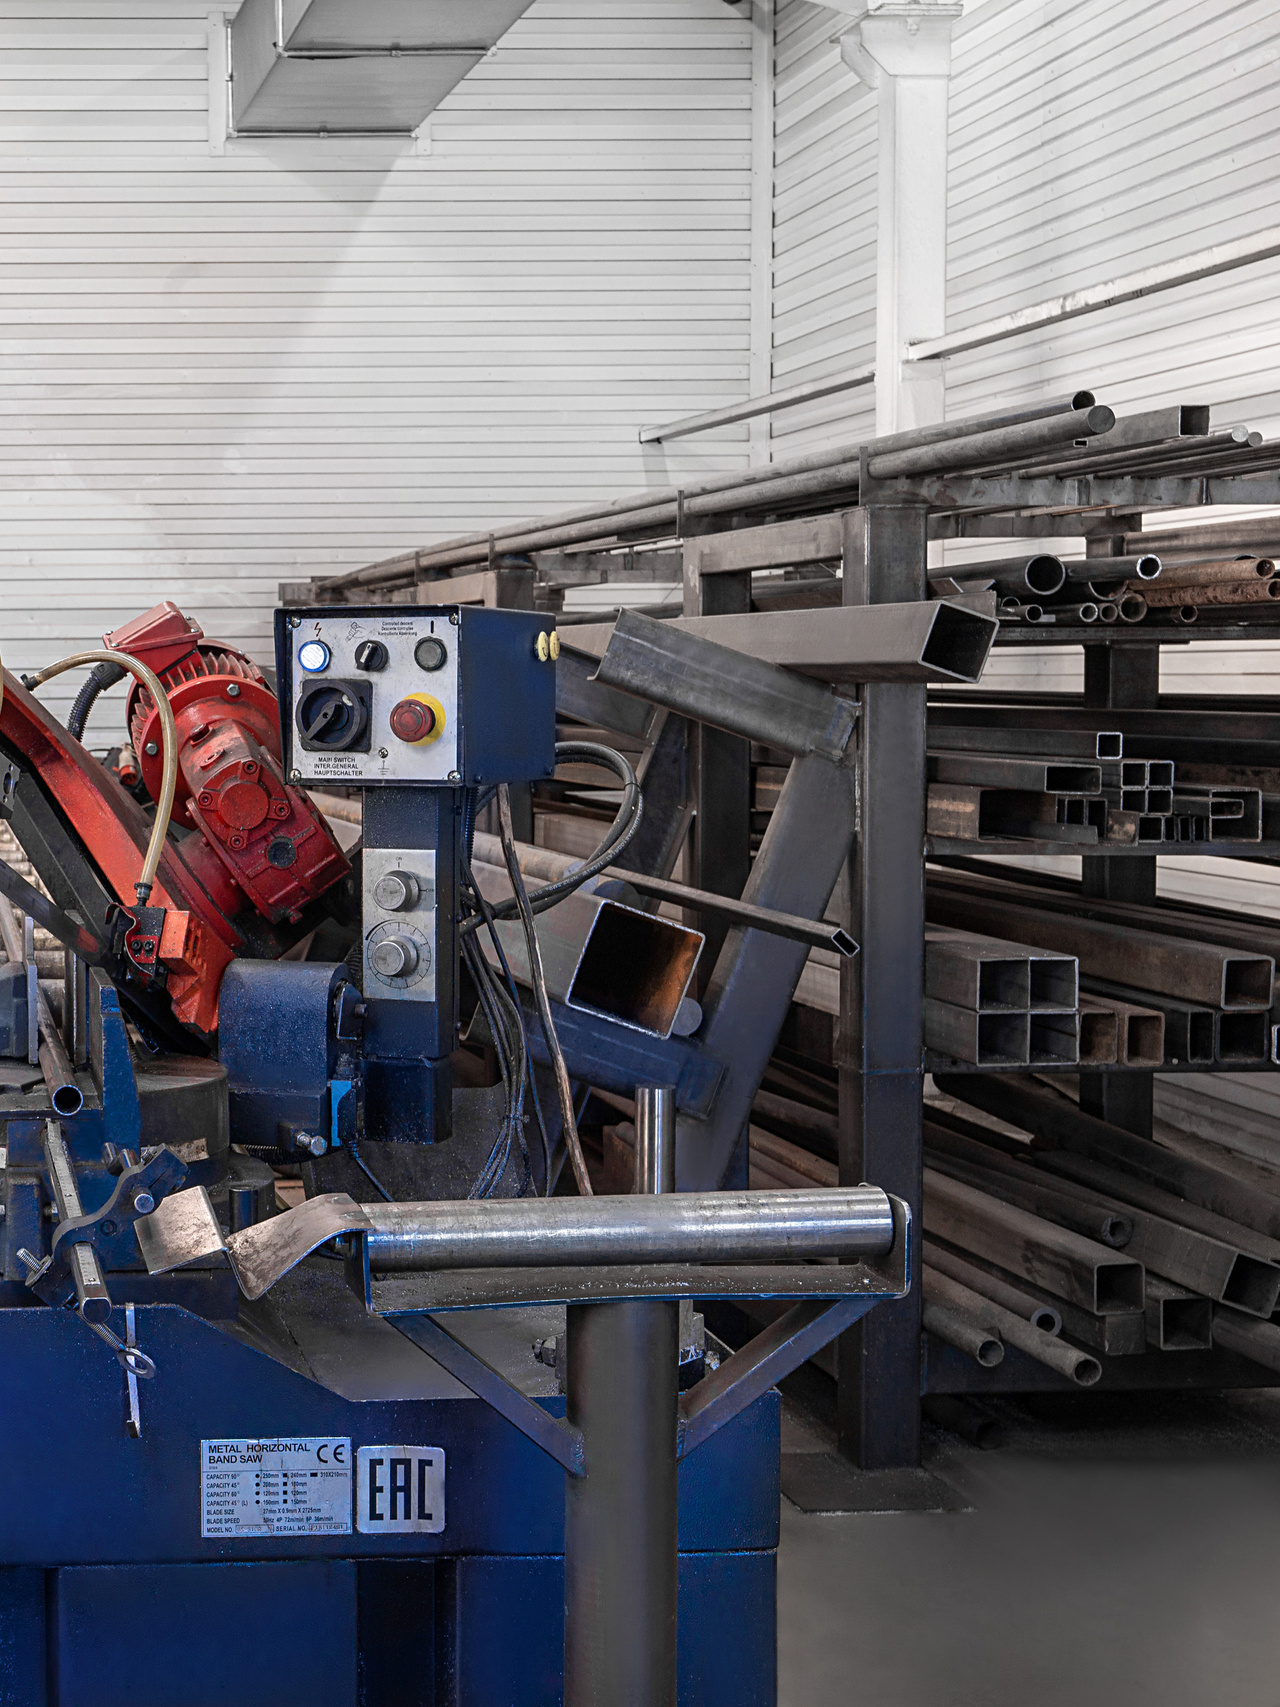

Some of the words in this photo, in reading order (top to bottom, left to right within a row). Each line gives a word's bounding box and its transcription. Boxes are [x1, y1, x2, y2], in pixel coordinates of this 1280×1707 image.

[208, 1444, 242, 1454] METAL
[246, 1443, 311, 1453] HORIZONTAL
[316, 1444, 345, 1464] CE
[208, 1455, 238, 1464] BAND
[240, 1454, 263, 1463] SAW
[369, 1458, 433, 1522] EAC
